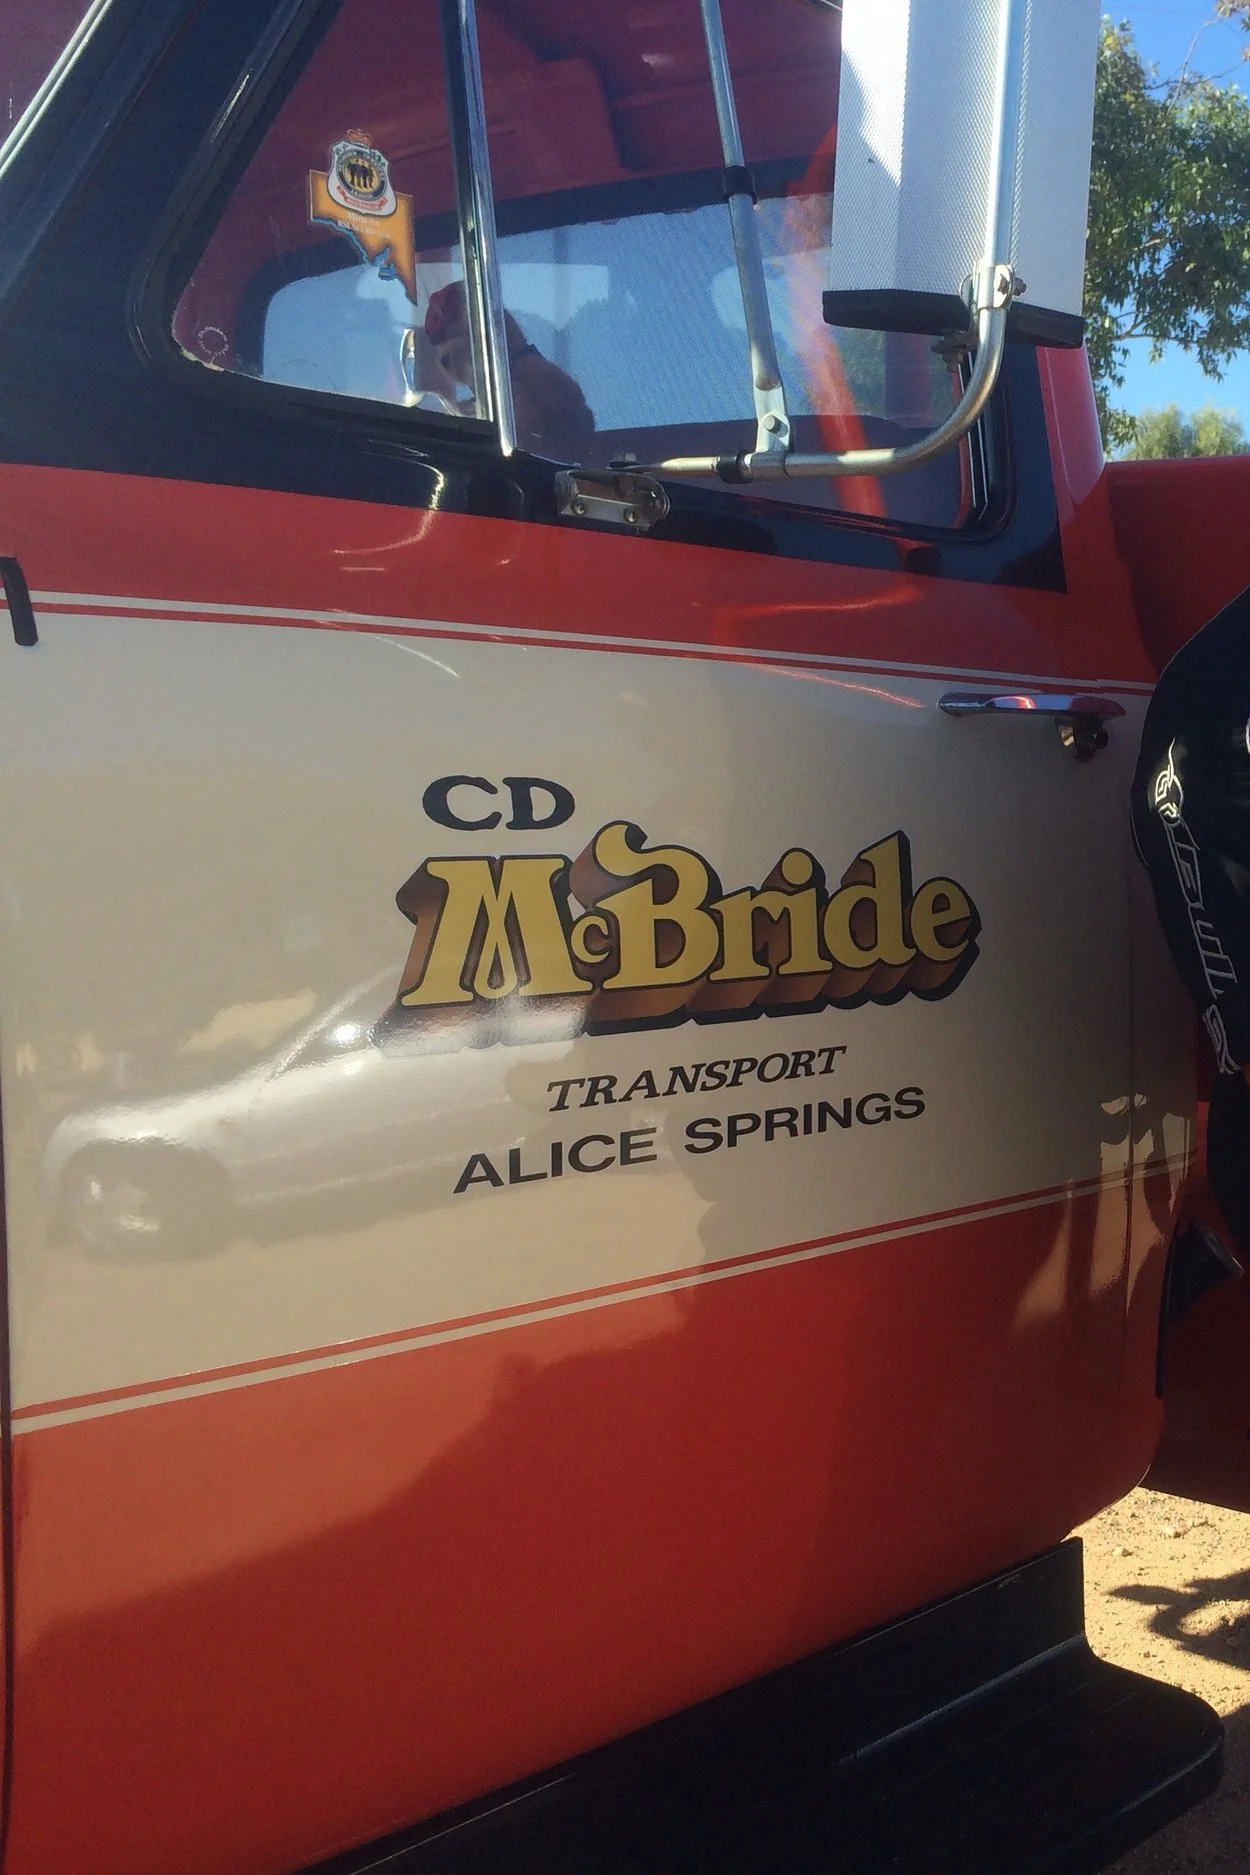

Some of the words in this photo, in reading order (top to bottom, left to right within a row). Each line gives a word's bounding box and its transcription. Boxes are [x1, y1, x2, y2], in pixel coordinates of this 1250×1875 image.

[422, 775, 575, 831] CD
[394, 820, 981, 1025] McBride
[546, 1045, 847, 1112] TRANSPORT
[453, 1127, 657, 1194] ALICE
[684, 1086, 926, 1154] SPRINGS
